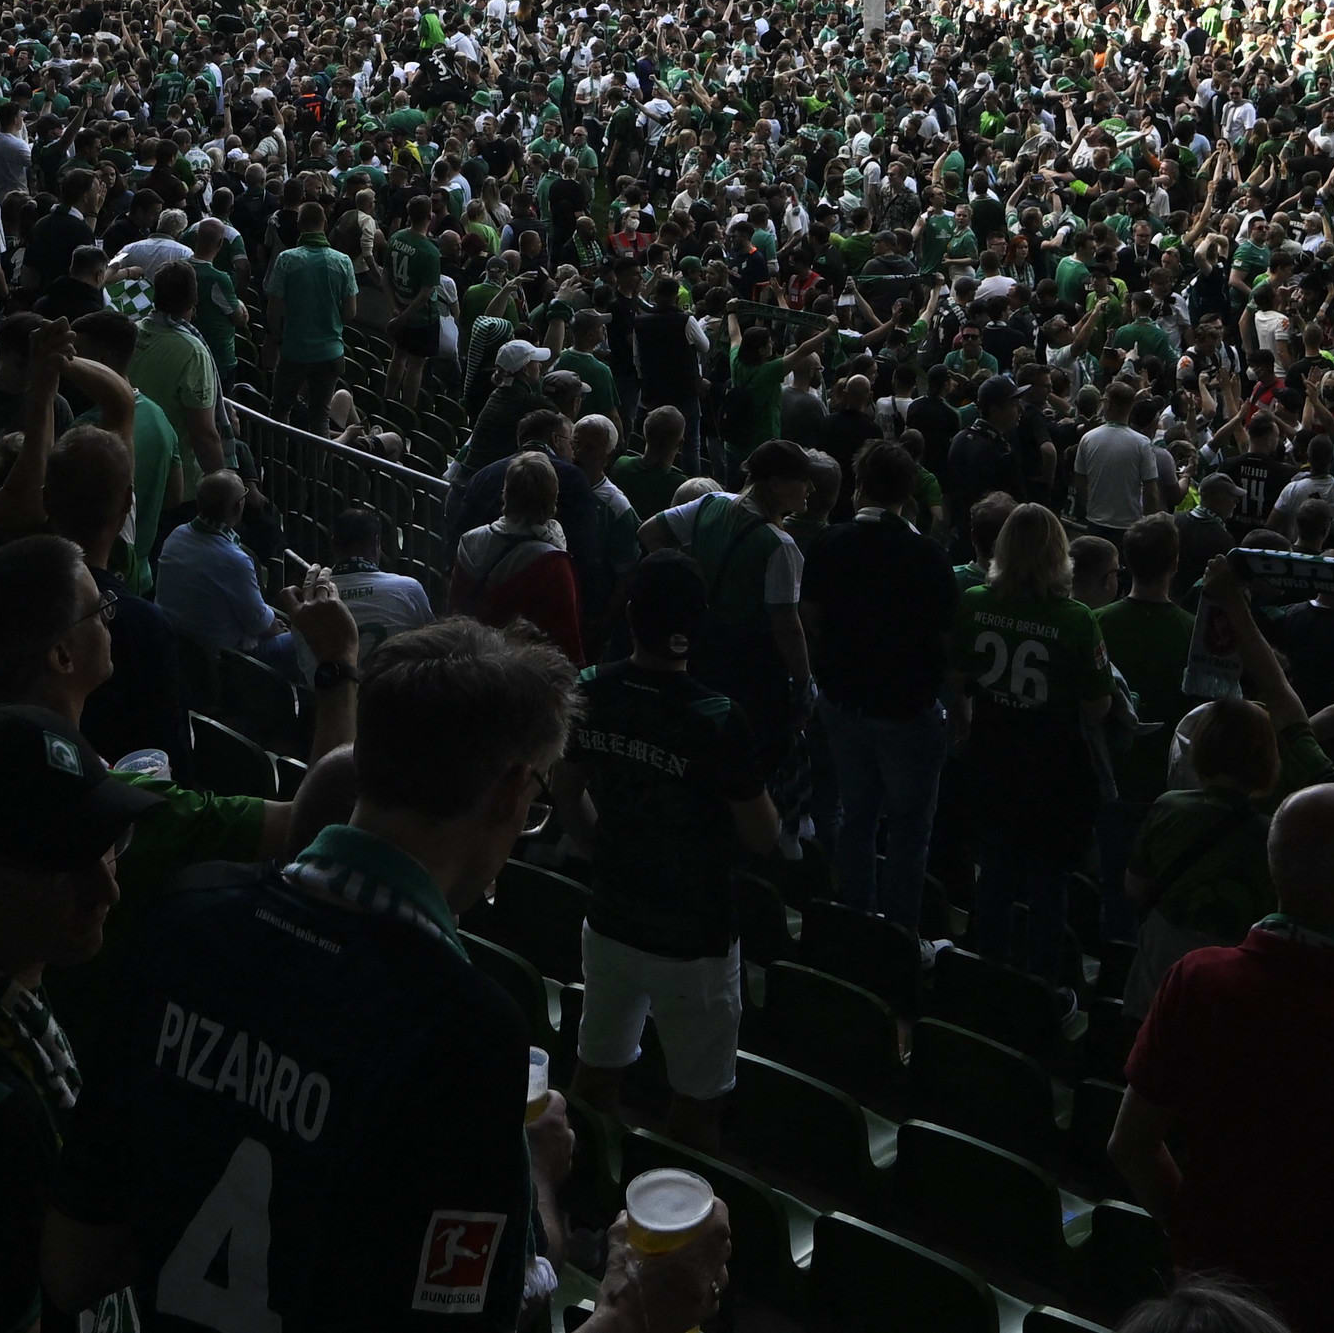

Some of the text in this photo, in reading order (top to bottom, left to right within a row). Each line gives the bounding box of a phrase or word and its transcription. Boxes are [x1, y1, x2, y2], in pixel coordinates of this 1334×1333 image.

[391, 251, 410, 286] 14
[341, 586, 373, 602] EMEN
[973, 611, 1059, 641] WERDER BREMEN
[973, 630, 1049, 708] 26
[156, 1001, 332, 1144] PIZARRO
[155, 1136, 283, 1333] 4
[420, 1289, 482, 1307] BUNDESLIGA
